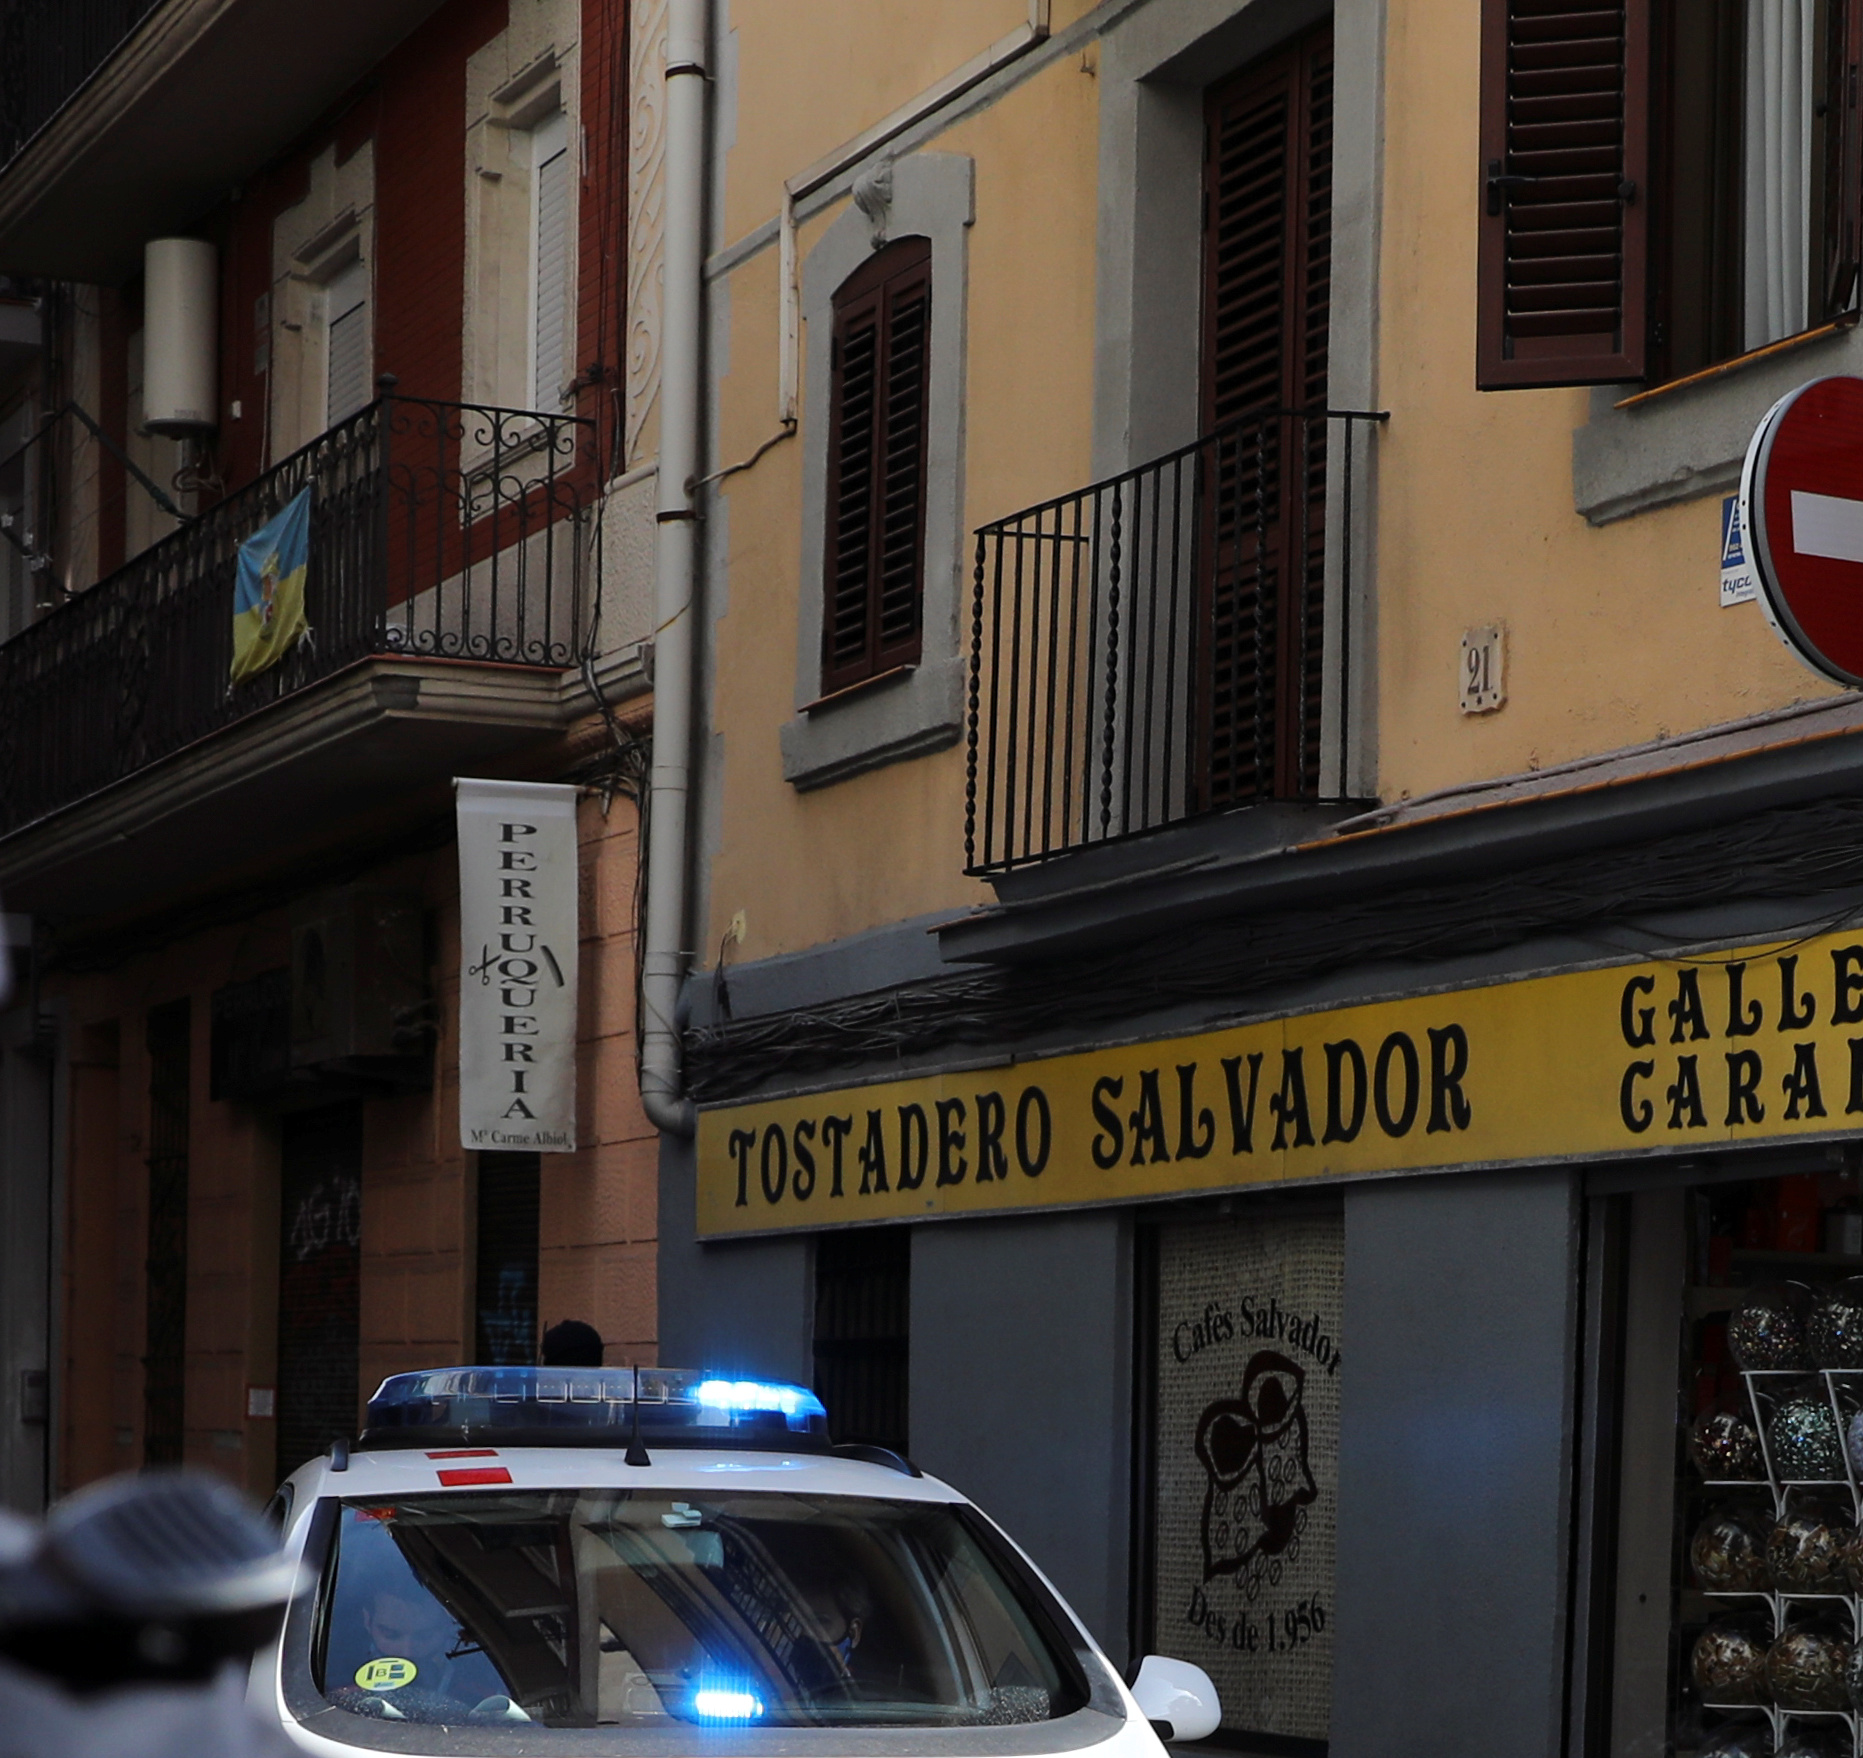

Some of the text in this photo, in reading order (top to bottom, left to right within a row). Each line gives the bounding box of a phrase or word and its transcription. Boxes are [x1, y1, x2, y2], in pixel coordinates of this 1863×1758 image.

[498, 823, 539, 1119] PERRUQUERIA
[491, 1130, 530, 1144] Carme
[729, 1023, 1472, 1208] TOSTADERO SALVADOR
[1241, 1295, 1342, 1375] Salvador
[1188, 1585, 1226, 1643] Des
[1233, 1611, 1259, 1652] de
